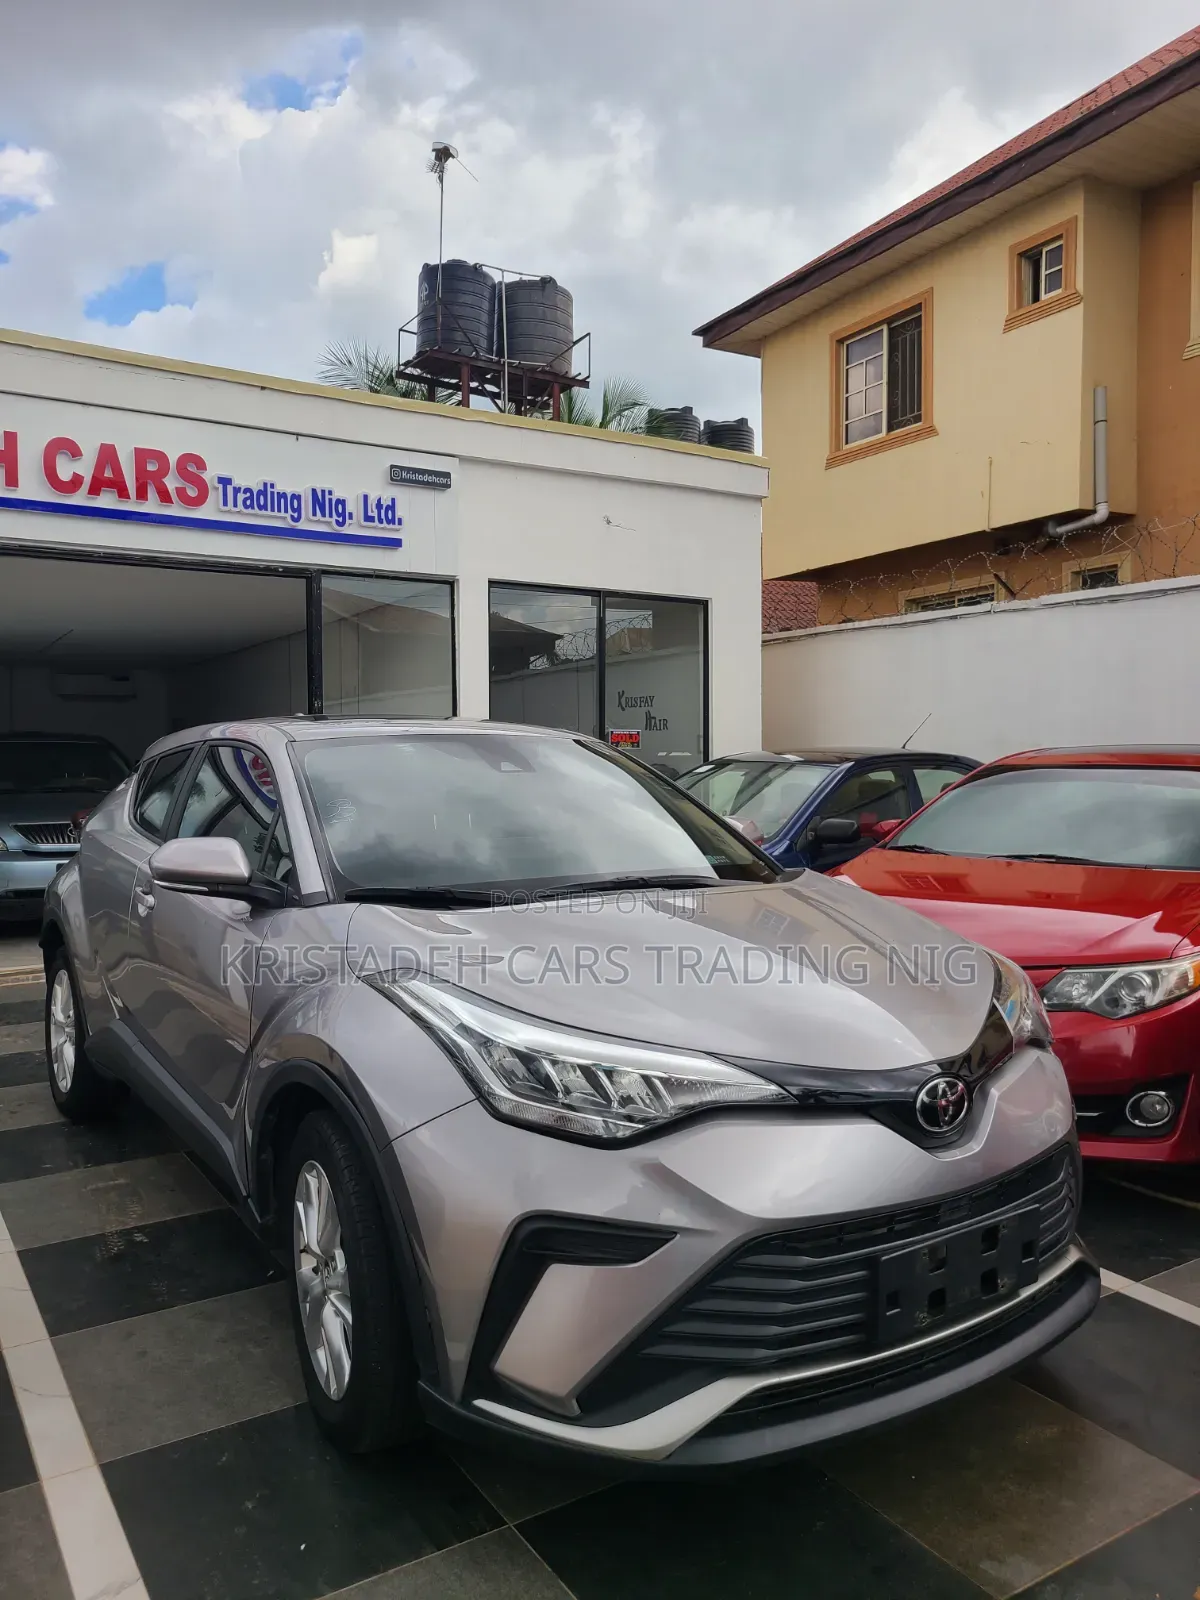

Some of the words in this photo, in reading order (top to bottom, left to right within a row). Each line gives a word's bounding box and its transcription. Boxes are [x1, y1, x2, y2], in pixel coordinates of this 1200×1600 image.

[42, 436, 209, 507] CARS
[217, 476, 301, 523] Trading
[311, 488, 353, 528] Nig.
[363, 494, 402, 526] Ltd.
[611, 733, 640, 743] SOLD
